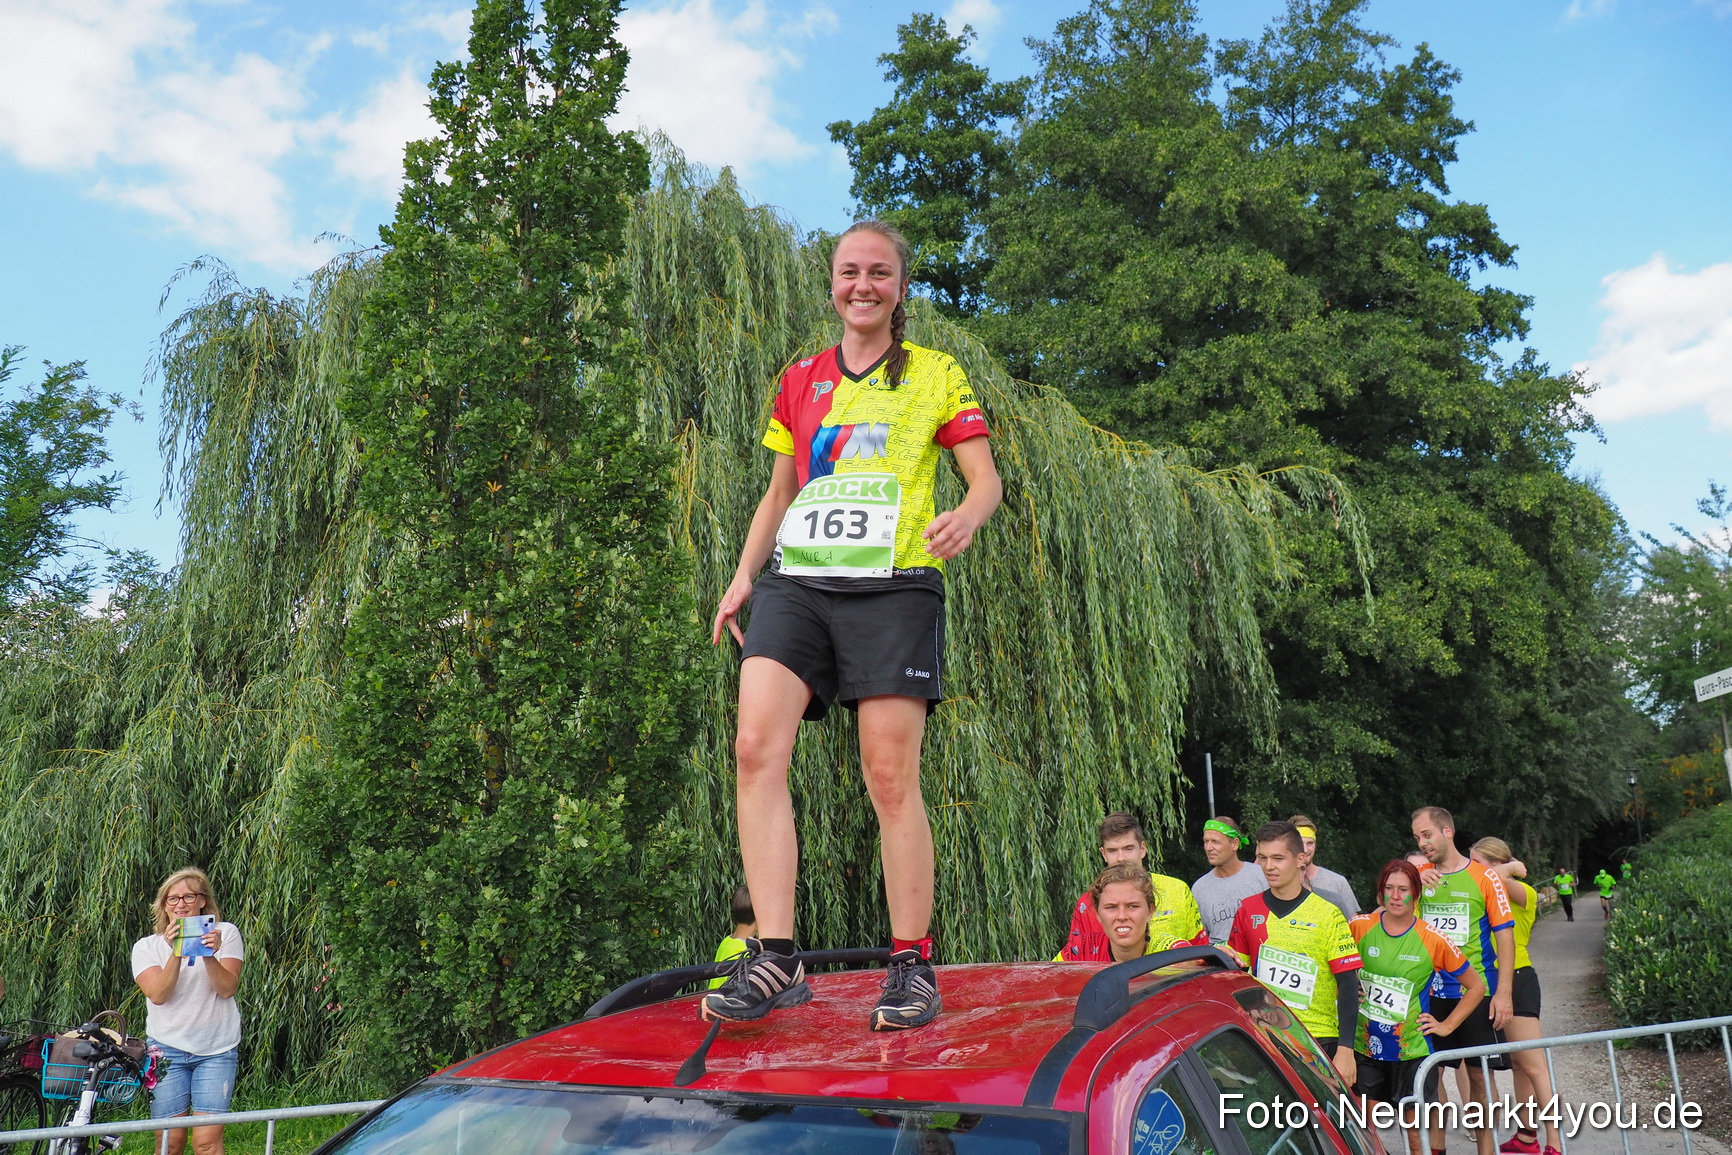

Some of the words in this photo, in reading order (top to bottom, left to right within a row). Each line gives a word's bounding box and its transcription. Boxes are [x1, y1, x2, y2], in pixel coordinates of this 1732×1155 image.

[798, 478, 889, 504] BOCK
[804, 509, 869, 540] 163
[914, 670, 930, 679] JAKO
[1484, 868, 1512, 917] BOCK
[1426, 904, 1464, 915] BOCK
[1433, 917, 1458, 930] 129
[1339, 942, 1357, 952] BMW
[1263, 948, 1312, 973] BOCK
[1269, 967, 1301, 989] 179
[1362, 969, 1406, 993] BOCK
[1368, 985, 1394, 1008] 124
